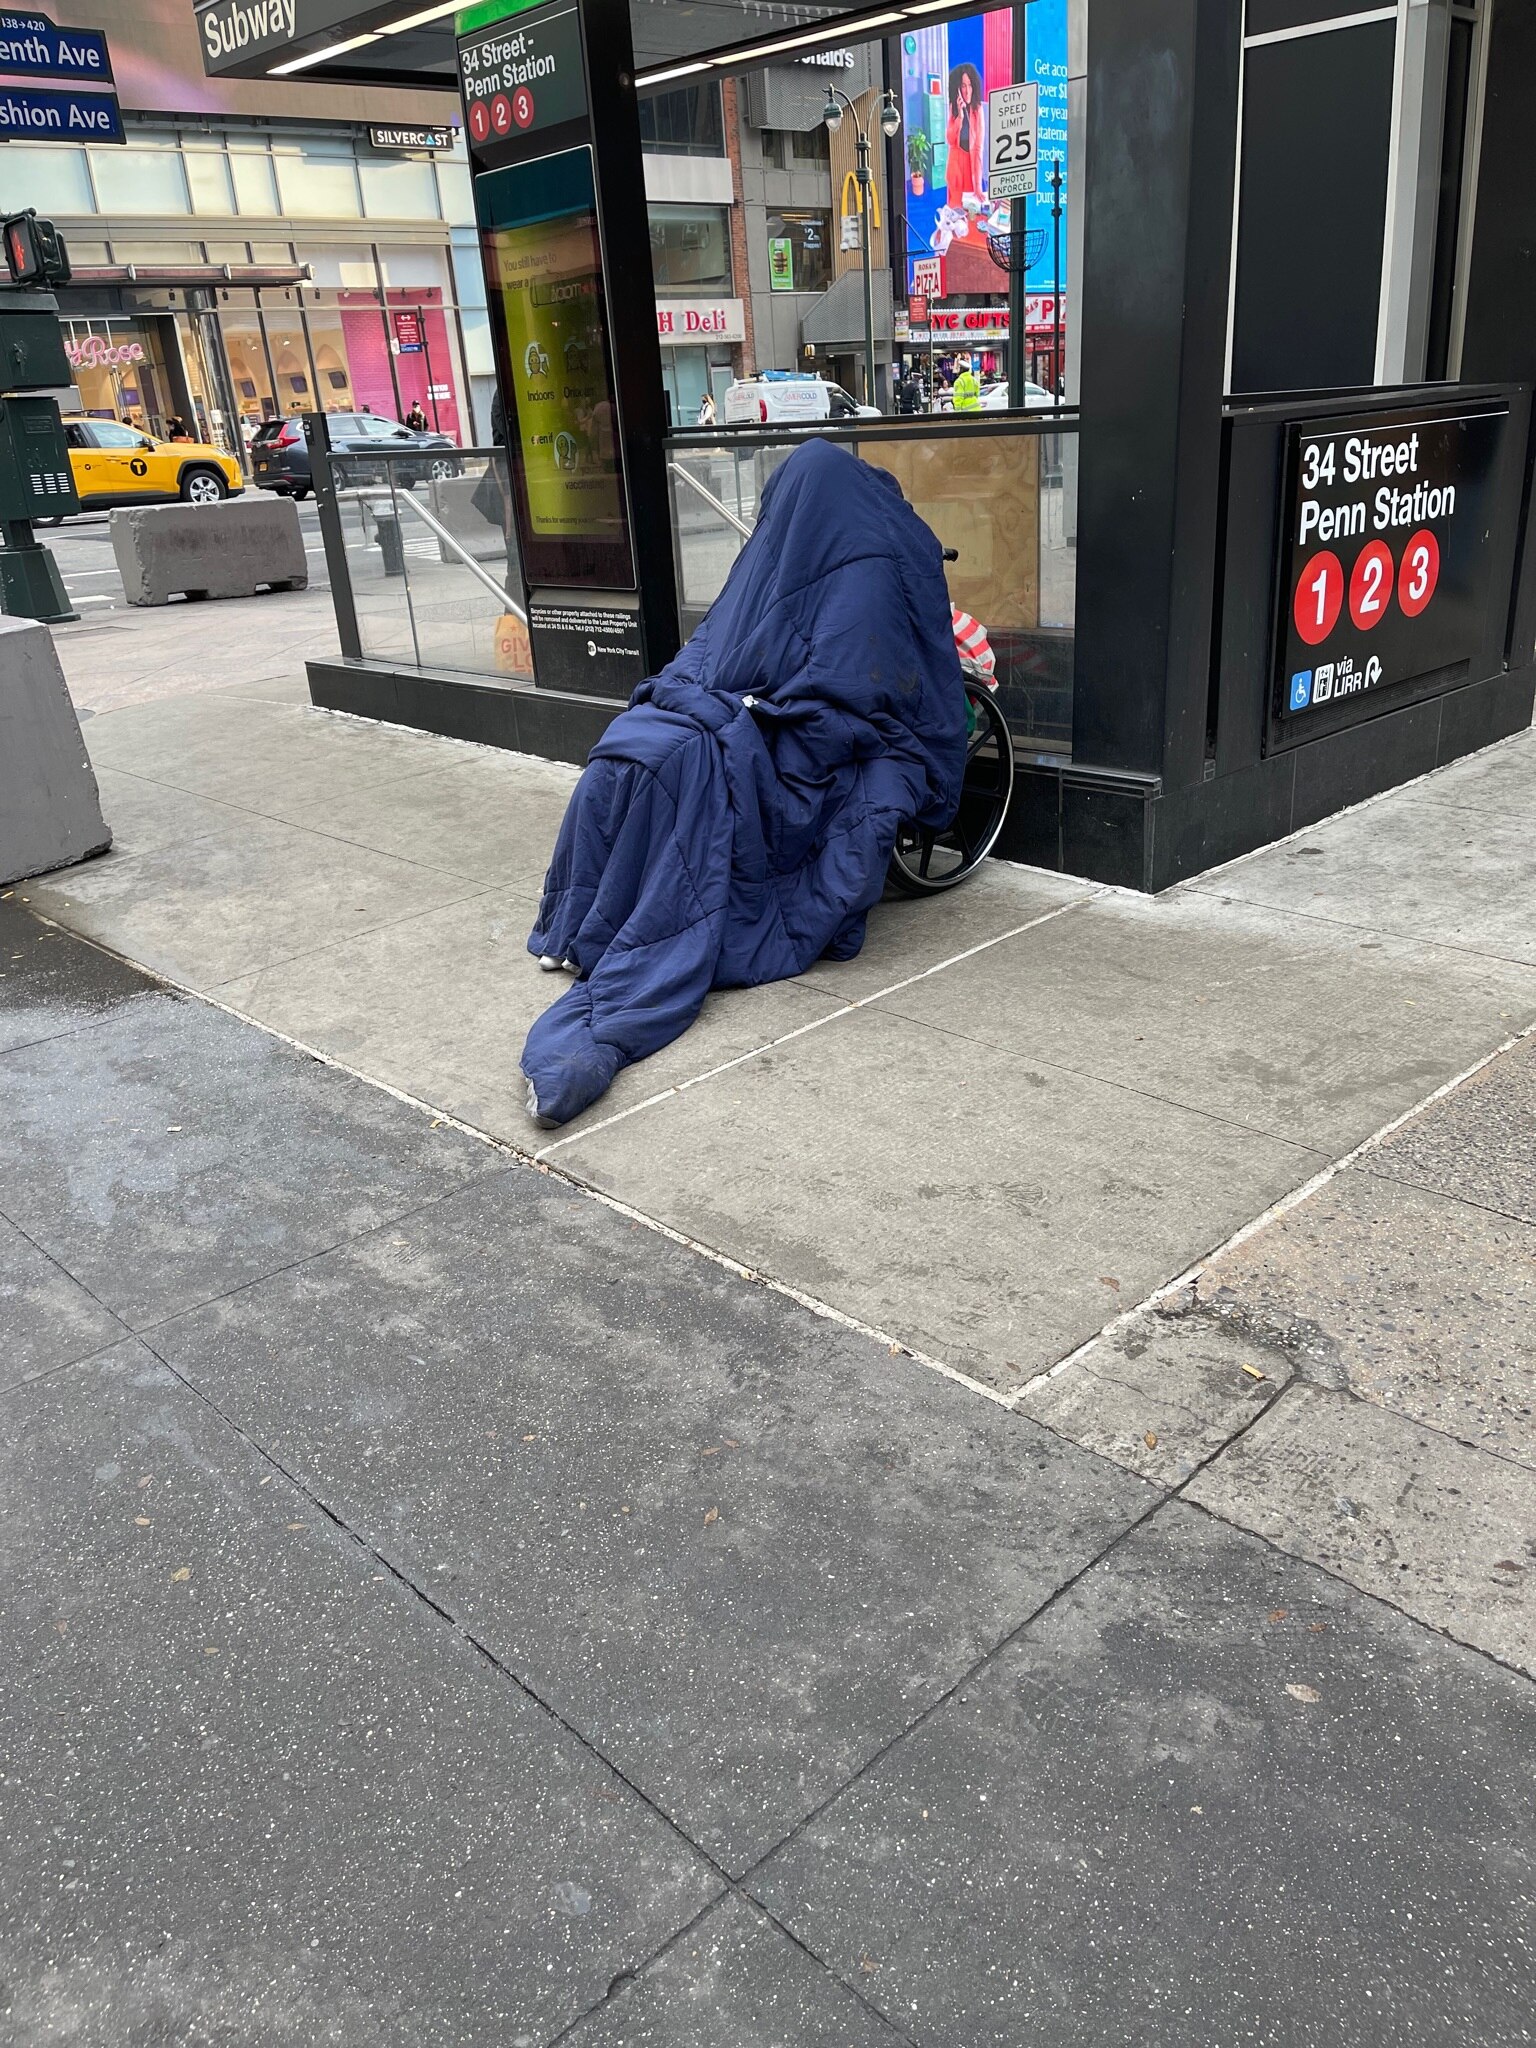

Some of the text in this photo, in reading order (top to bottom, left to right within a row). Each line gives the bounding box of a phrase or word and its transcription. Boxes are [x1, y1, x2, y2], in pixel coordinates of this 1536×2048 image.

[27, 21, 45, 31] 420
[205, 0, 295, 58] Subway
[0, 37, 100, 67] enth Ave
[462, 49, 479, 74] 34
[481, 32, 526, 67] Street
[464, 54, 555, 100] Penn Station
[1034, 59, 1050, 76] Get
[1002, 91, 1023, 103] CITY
[1038, 85, 1057, 97] over
[0, 99, 110, 129] shion Ave
[475, 96, 528, 132] 1 2 3
[998, 103, 1027, 117] SPEED
[1001, 116, 1024, 129] LIMIT
[995, 130, 1031, 164] 25
[992, 181, 1032, 195] ENFORCED
[1000, 173, 1025, 185] PHOTO
[503, 259, 517, 272] You
[657, 310, 726, 332] H Deli
[527, 390, 555, 401] Indoors
[1302, 433, 1419, 489] 34 Street
[1299, 480, 1455, 545] Penn Station
[1311, 546, 1429, 625] 1 2 3
[1336, 656, 1353, 676] via
[1333, 671, 1362, 698] LIRR
